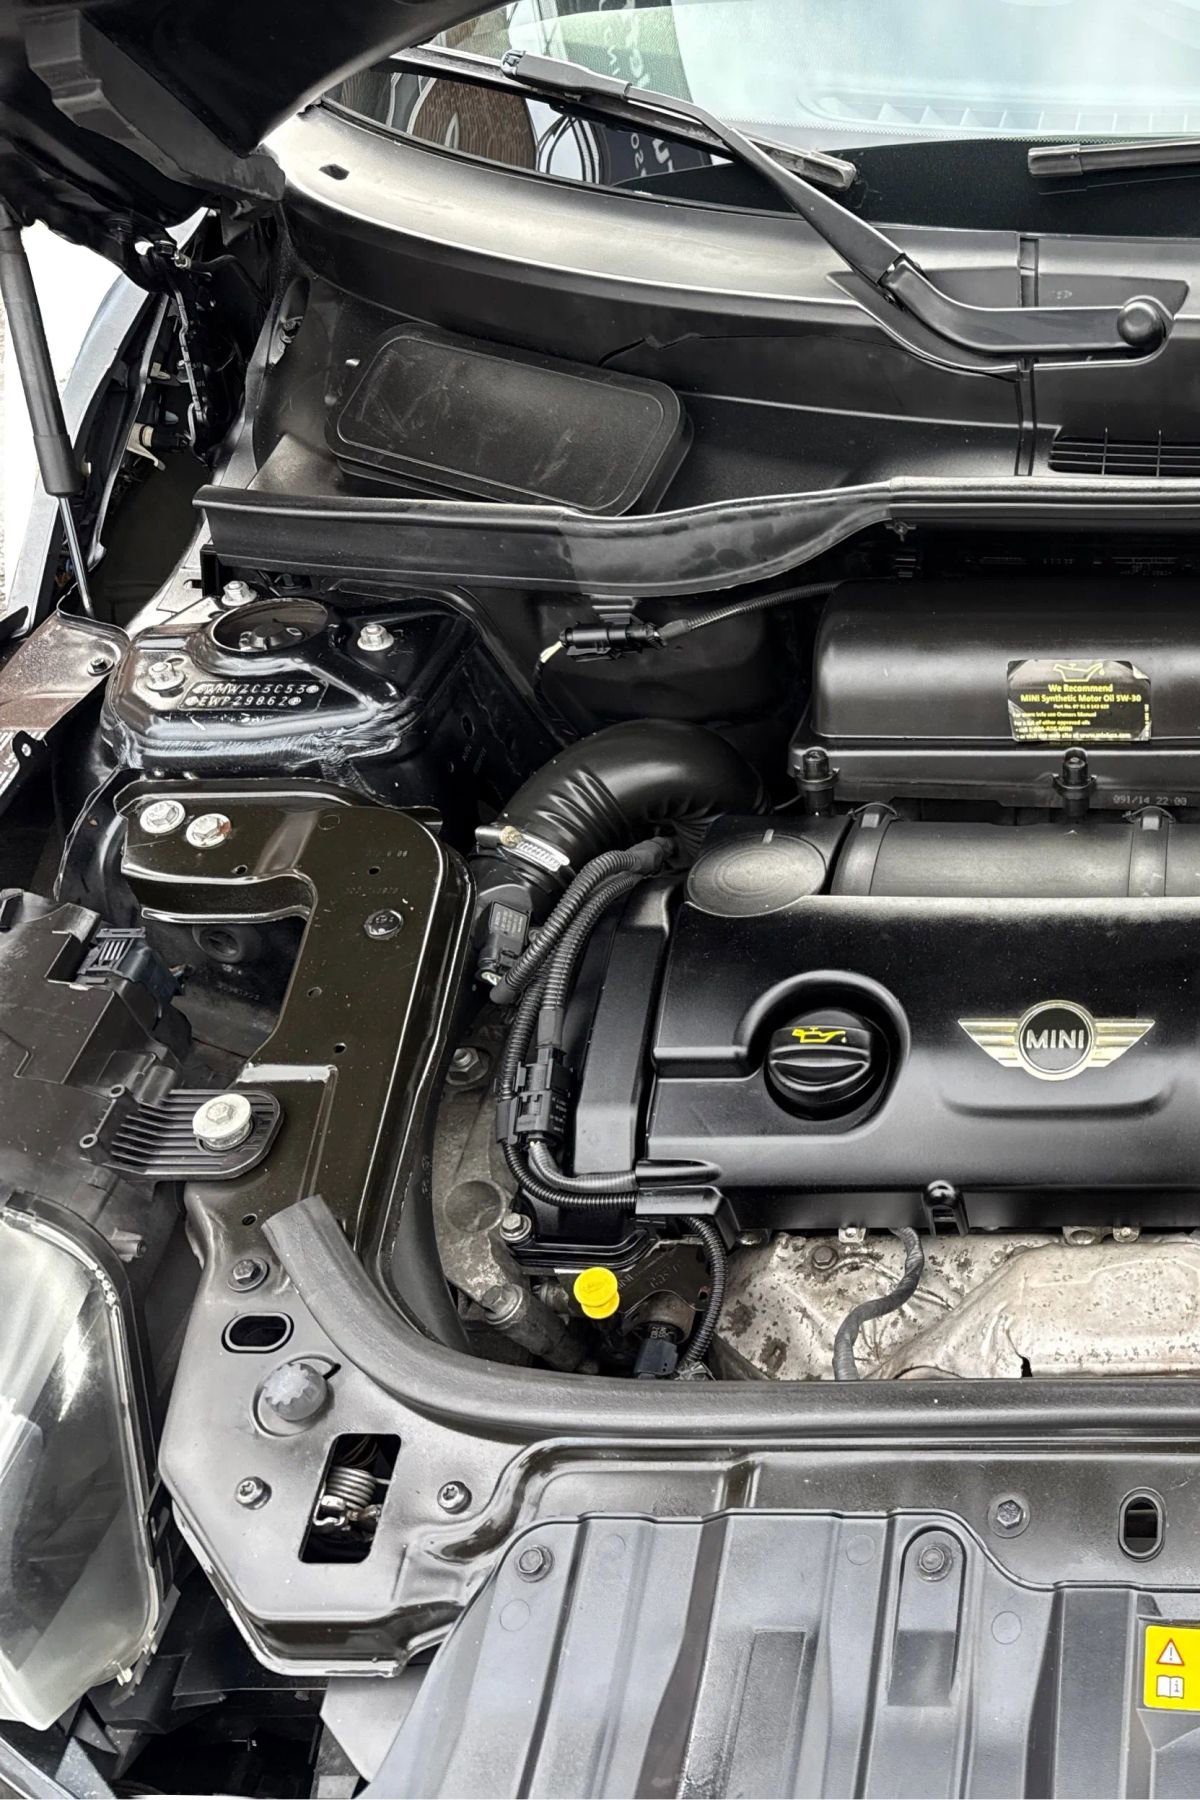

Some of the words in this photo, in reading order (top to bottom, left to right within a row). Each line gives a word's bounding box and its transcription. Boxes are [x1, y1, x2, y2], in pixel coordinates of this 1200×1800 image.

[1048, 684, 1062, 692] We
[1063, 683, 1113, 692] Recommend
[1020, 694, 1040, 702] MINI
[1041, 694, 1077, 704] Synthetic
[1078, 694, 1101, 702] Motor
[1103, 694, 1115, 702] Oil
[1116, 694, 1142, 702] 5W-30
[1026, 1029, 1084, 1049] MINI
